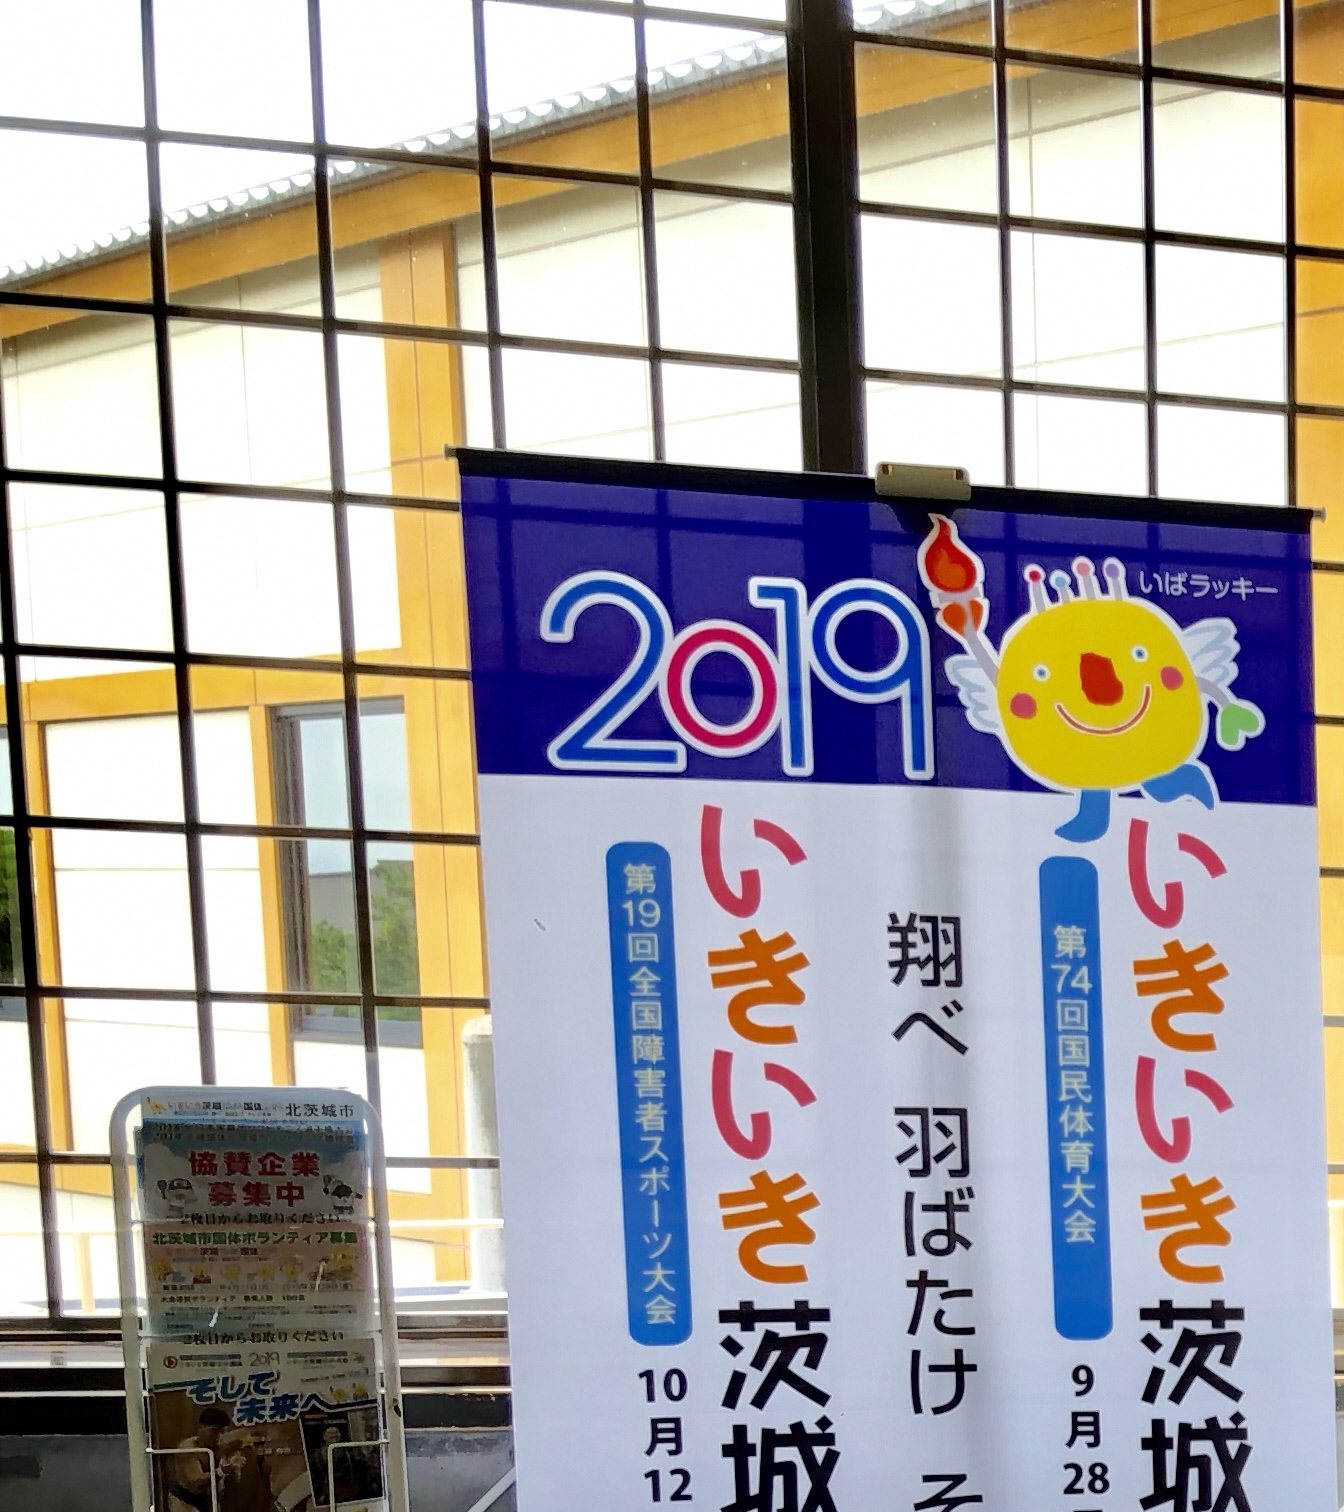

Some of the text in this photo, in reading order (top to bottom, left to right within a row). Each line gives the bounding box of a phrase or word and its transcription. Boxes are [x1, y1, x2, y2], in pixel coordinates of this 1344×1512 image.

[1138, 570, 1279, 599] いばラッキー
[540, 569, 934, 780] 2019
[622, 863, 677, 1327] 第19回全国障害者スポーツ大会
[1052, 923, 1098, 1245] 第74回国民体育大会
[285, 1103, 354, 1118] 北茨城市
[188, 1151, 320, 1177] 協賛企業
[208, 1181, 304, 1207] 募集中
[249, 1352, 281, 1367] 2019
[187, 1371, 278, 1403] そして
[235, 1393, 331, 1424] 未来へ
